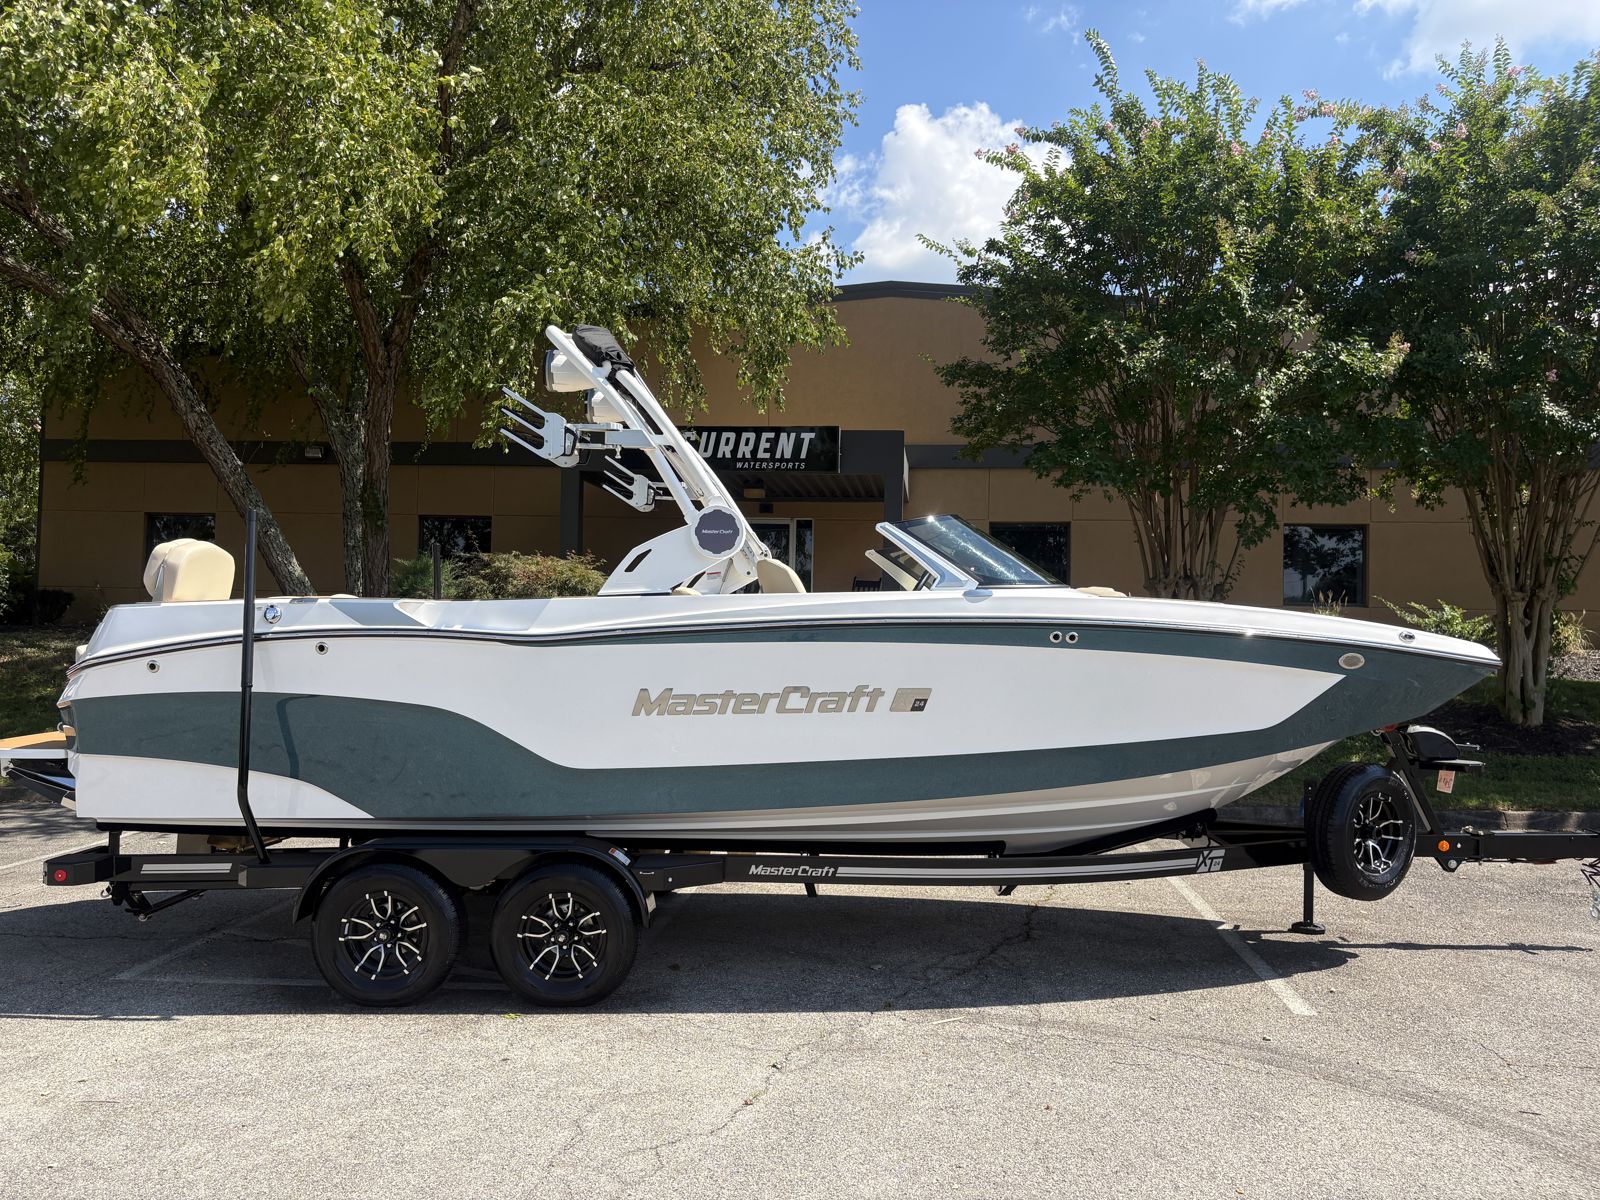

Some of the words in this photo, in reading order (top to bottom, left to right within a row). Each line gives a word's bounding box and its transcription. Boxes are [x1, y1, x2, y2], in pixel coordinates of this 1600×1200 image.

[736, 461, 806, 470] WATERSPORTS
[631, 684, 885, 717] MasterCraft
[748, 864, 835, 877] MasterCraft
